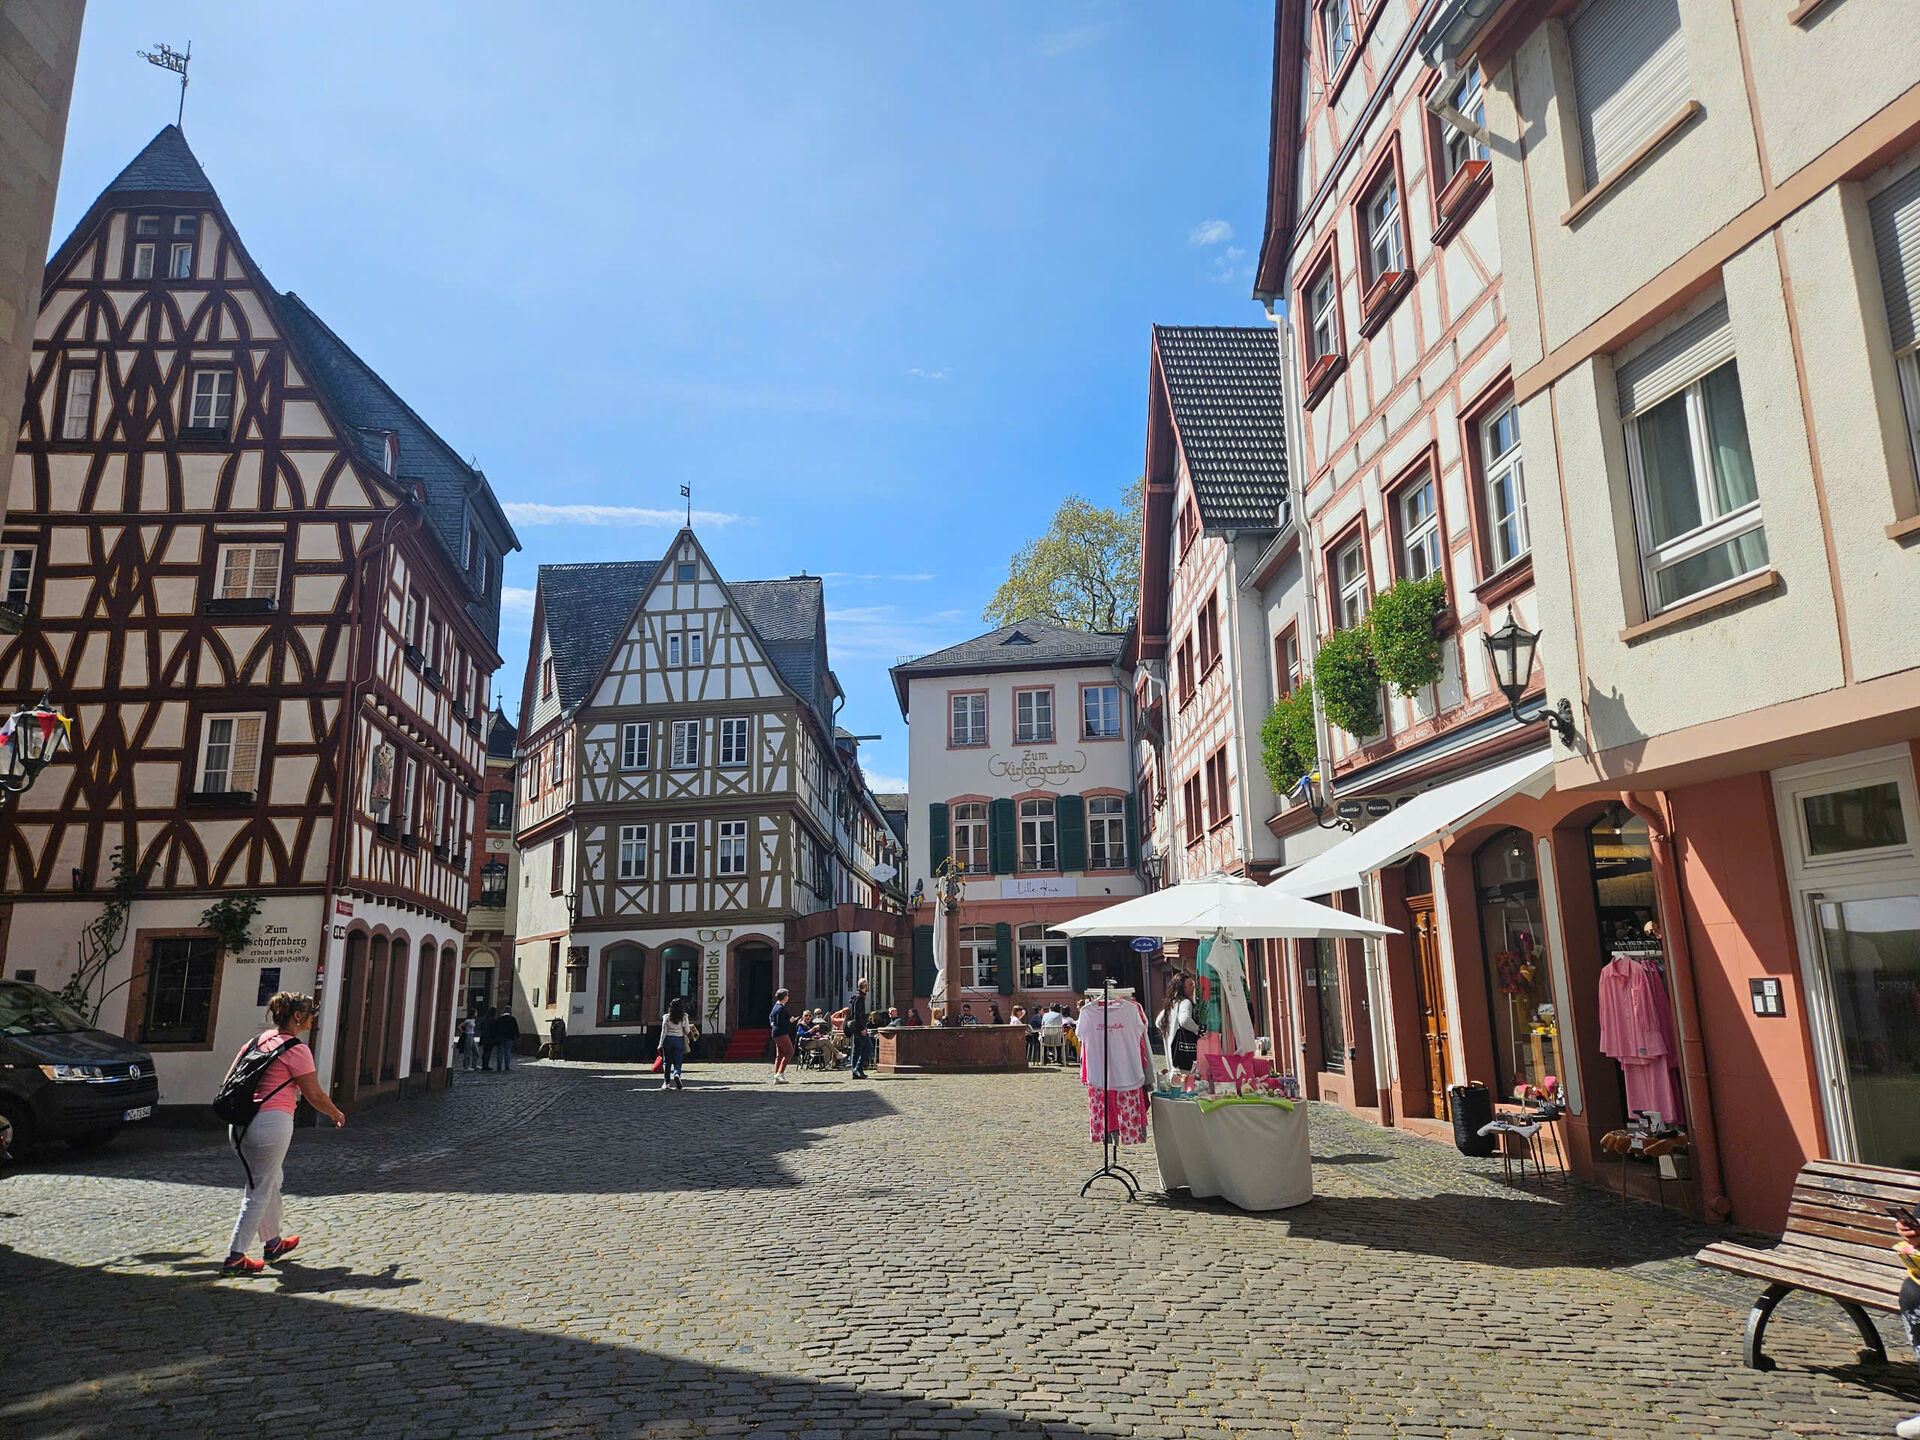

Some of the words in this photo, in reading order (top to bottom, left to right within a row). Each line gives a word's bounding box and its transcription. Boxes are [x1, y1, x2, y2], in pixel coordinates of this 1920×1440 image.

[1022, 749, 1048, 761] Zum
[998, 760, 1080, 787] Kirschgarten
[265, 925, 288, 934] Zum
[245, 937, 307, 947] schaffenberg
[704, 949, 720, 1019] Augenblick
